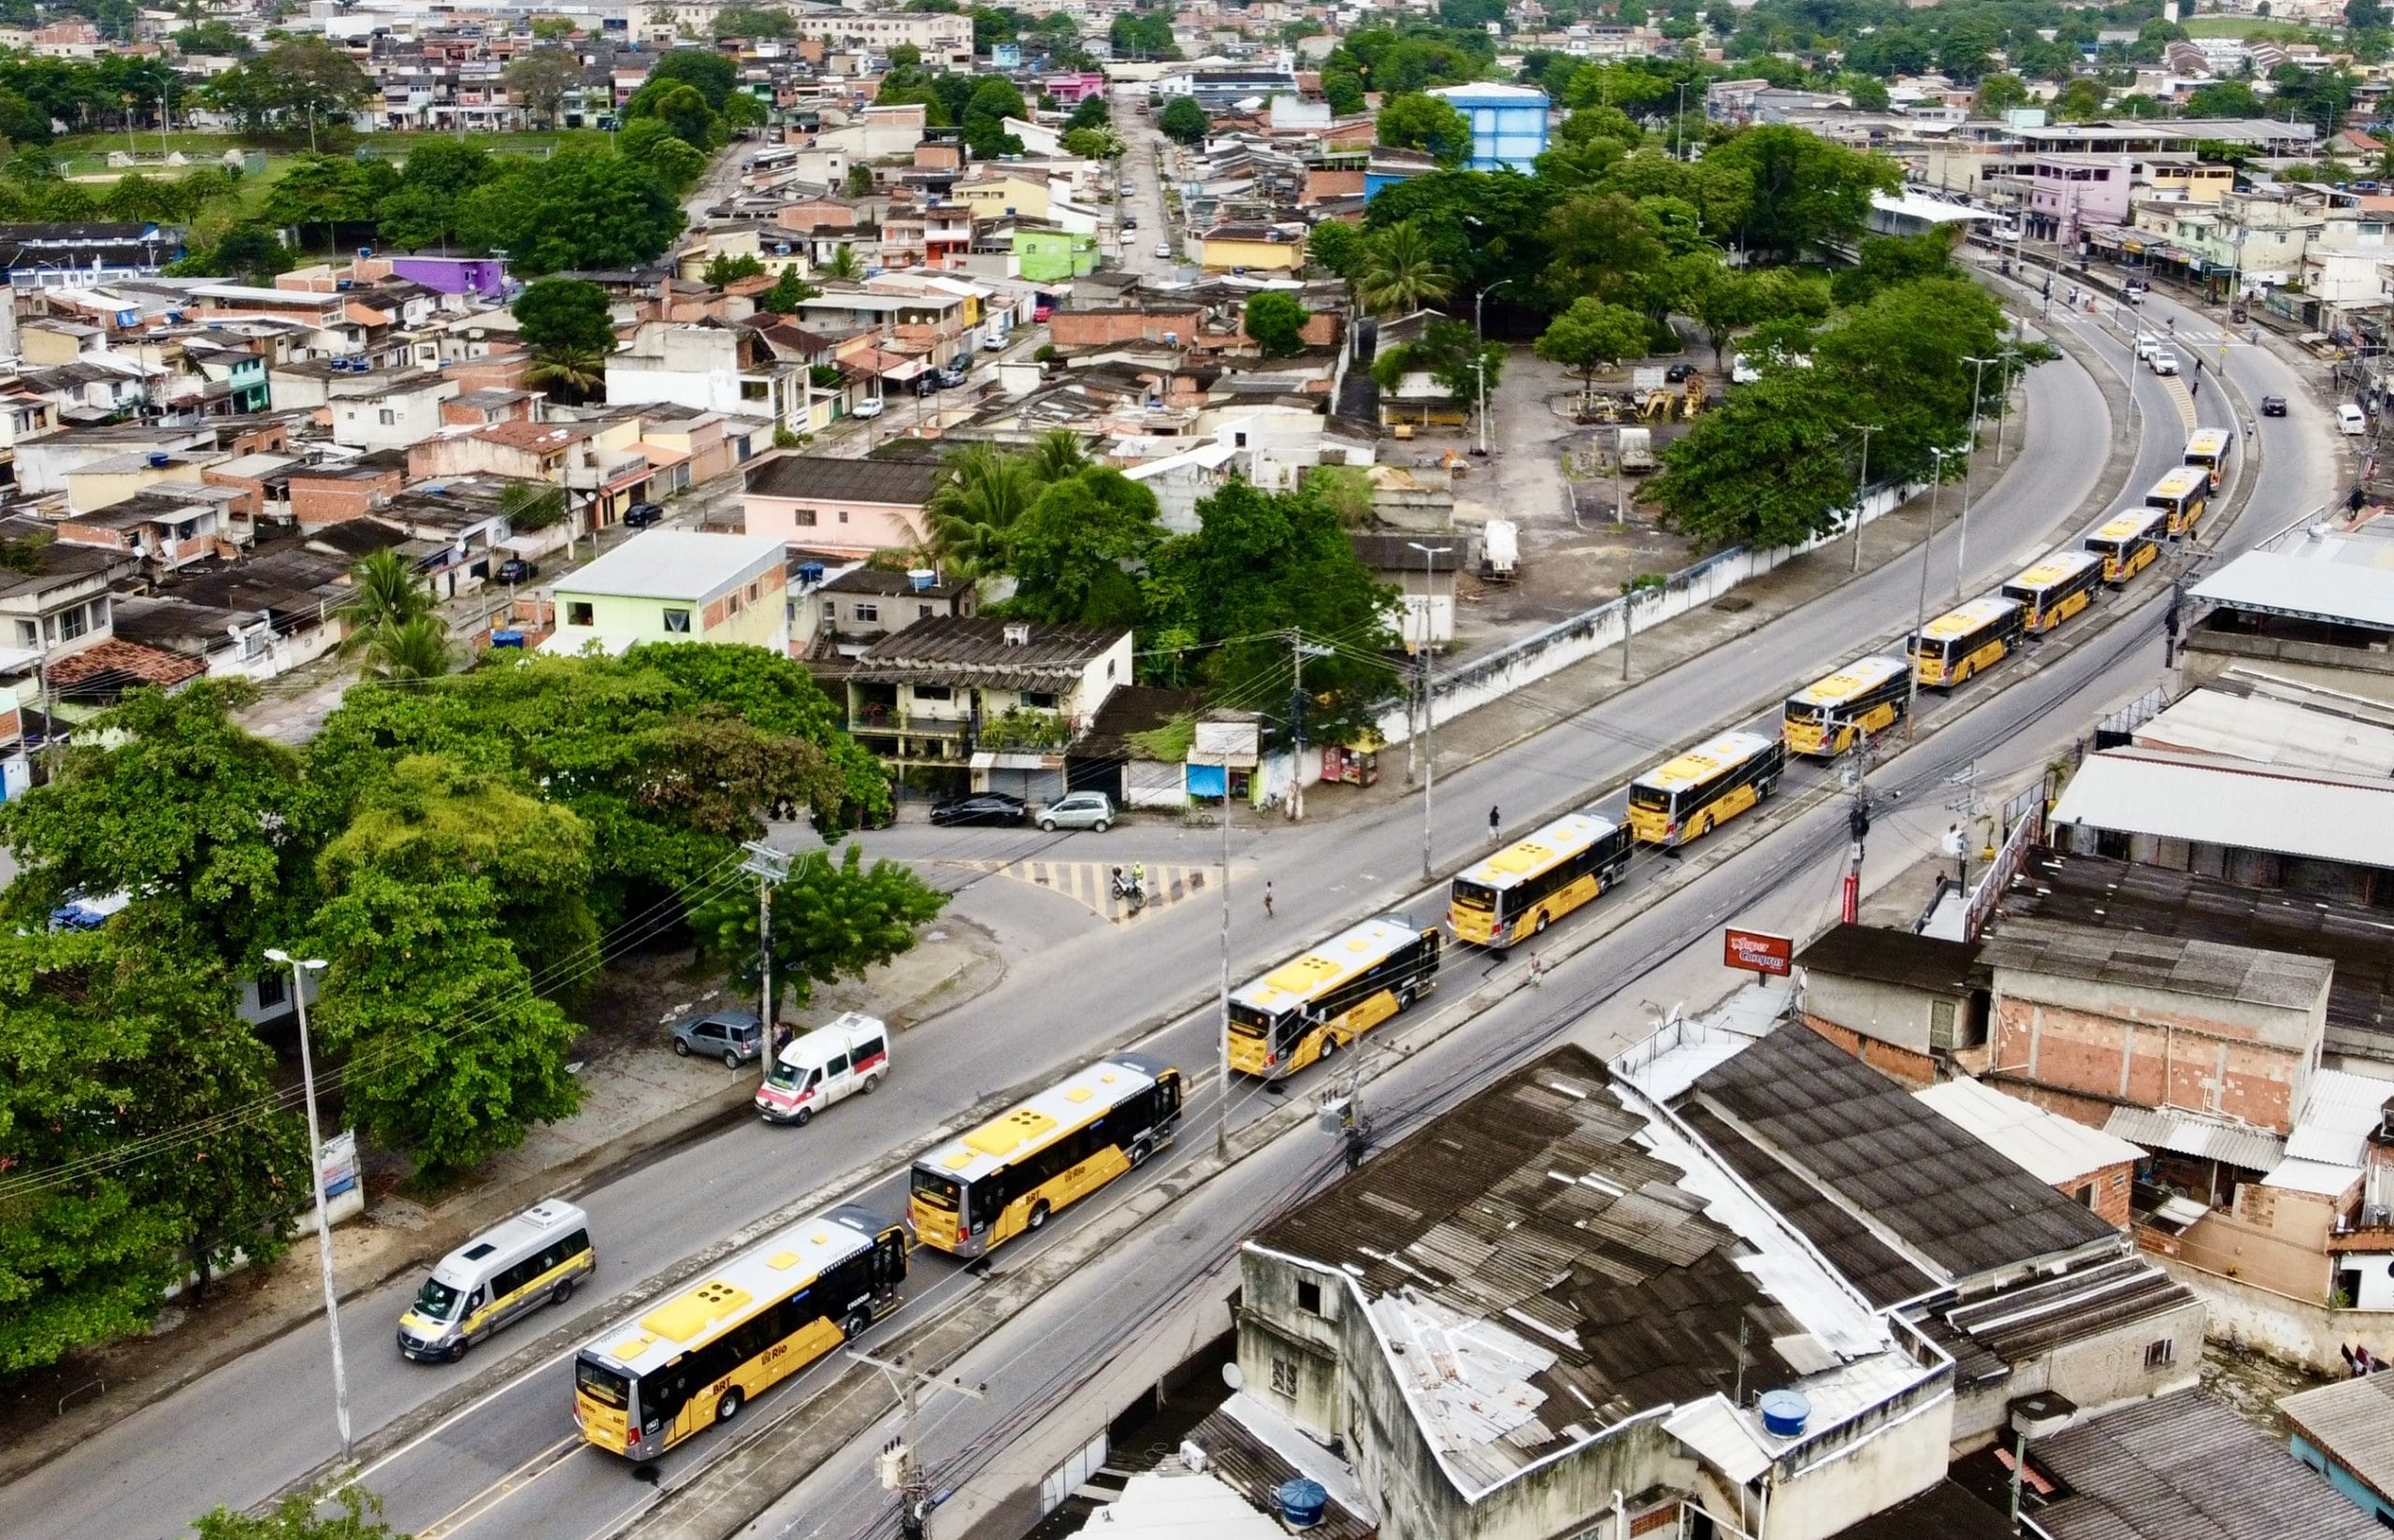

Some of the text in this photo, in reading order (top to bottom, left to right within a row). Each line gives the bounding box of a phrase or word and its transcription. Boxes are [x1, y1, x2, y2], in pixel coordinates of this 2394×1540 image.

[1025, 1189, 1041, 1205] BRT
[772, 1345, 787, 1360] Rio
[712, 1376, 731, 1395] BRT
